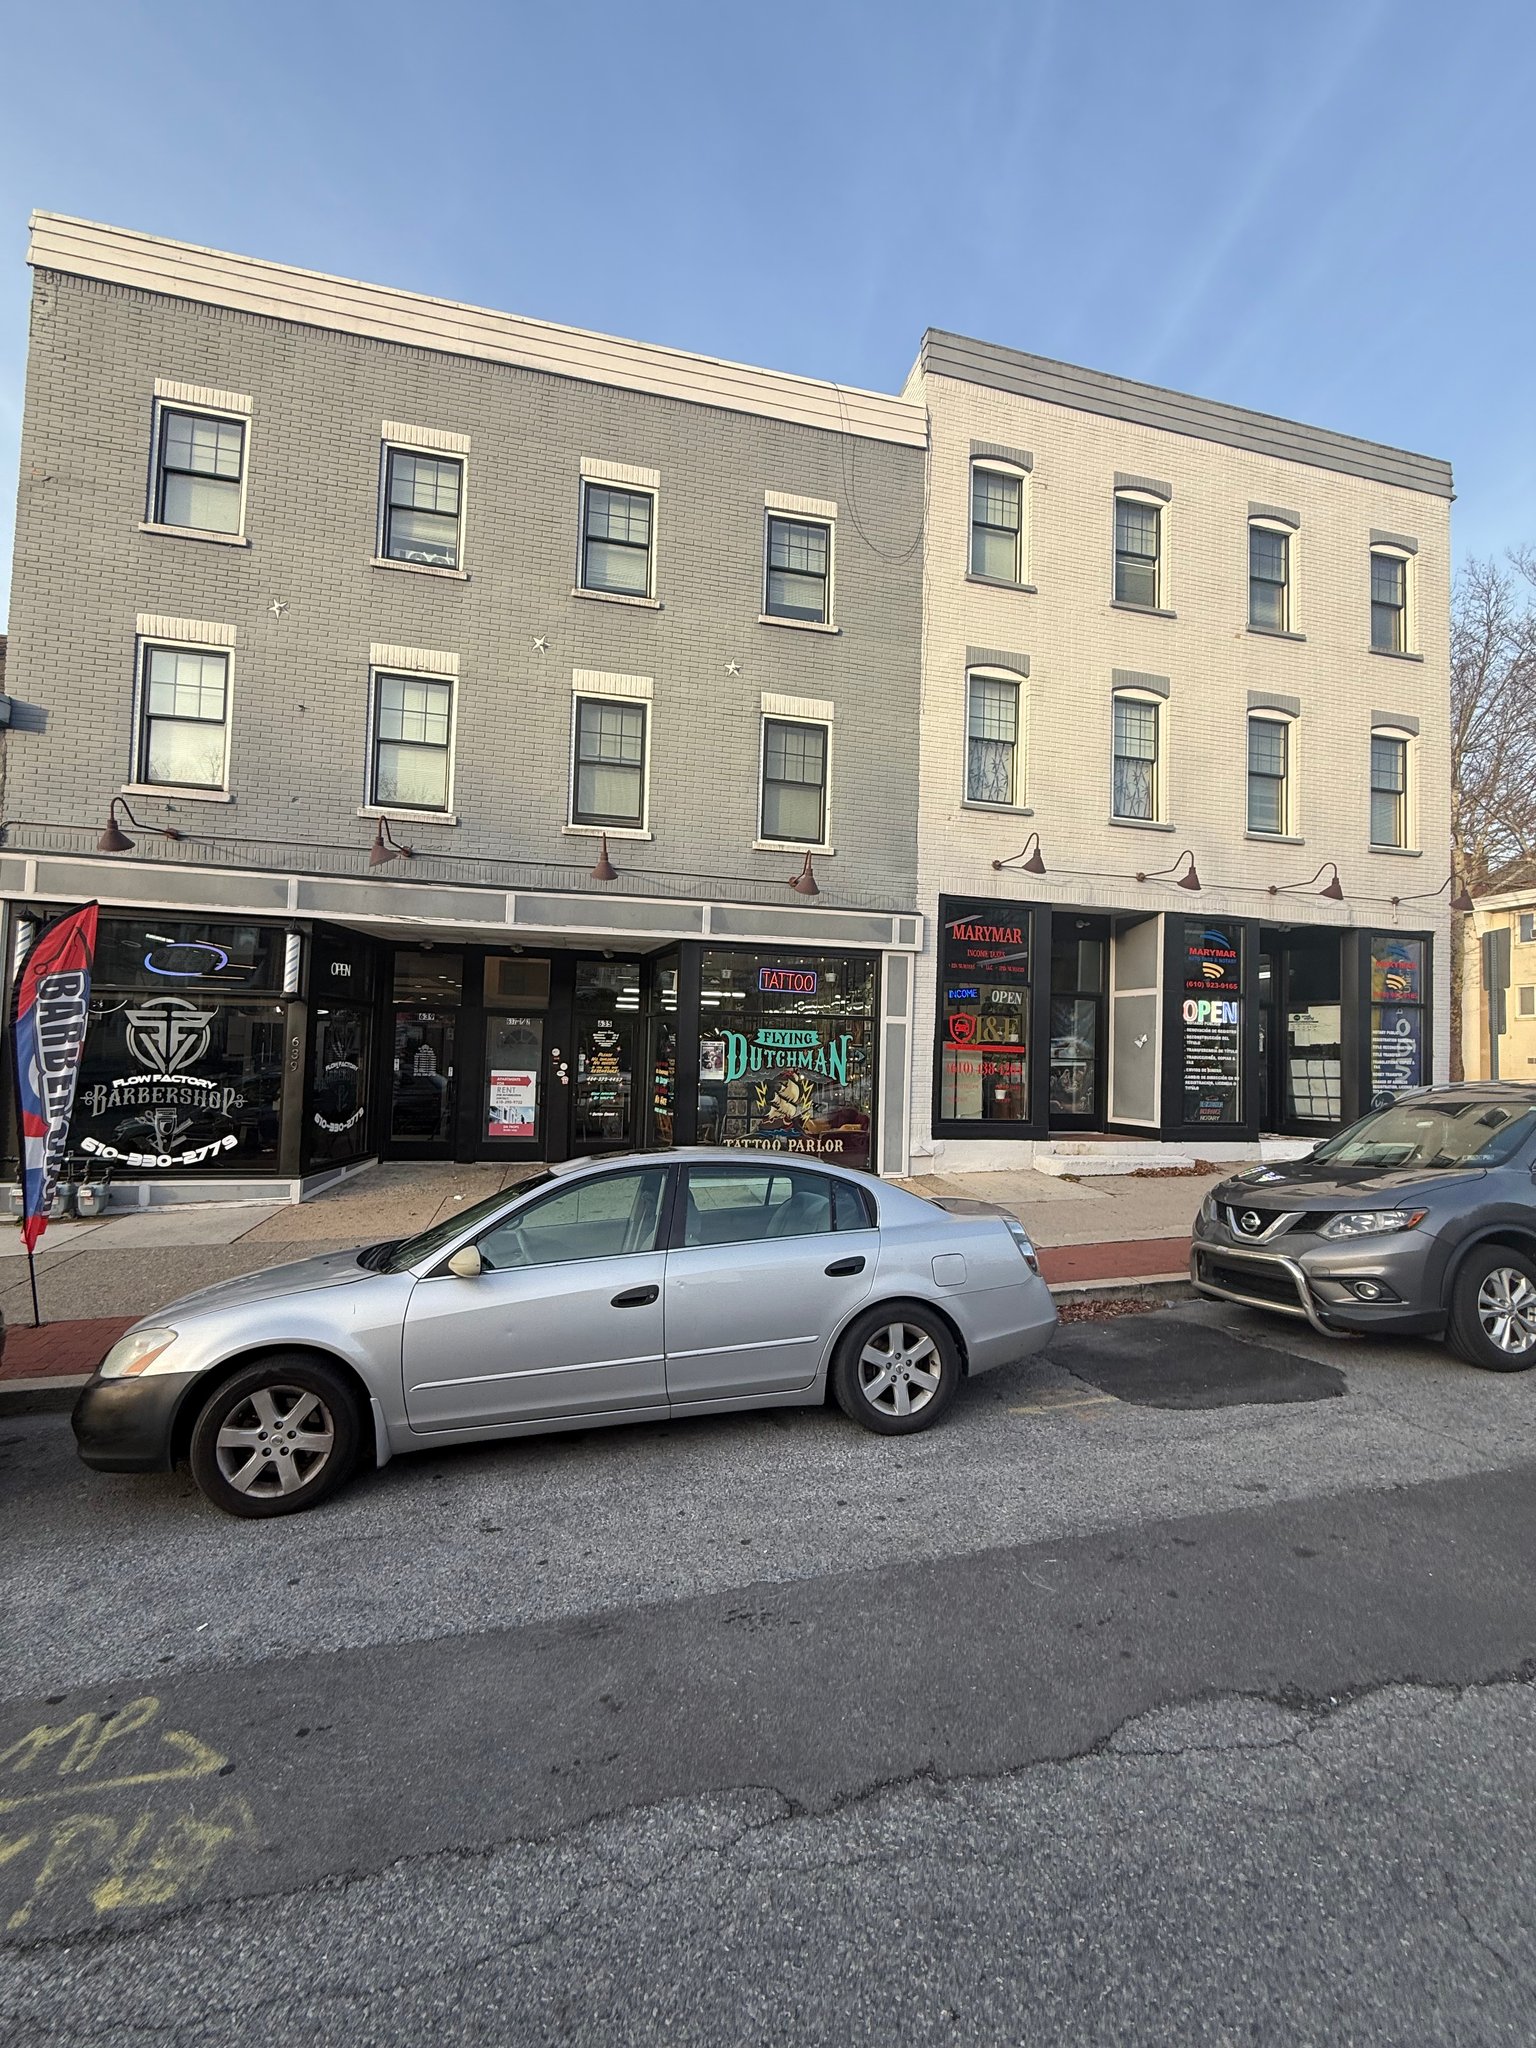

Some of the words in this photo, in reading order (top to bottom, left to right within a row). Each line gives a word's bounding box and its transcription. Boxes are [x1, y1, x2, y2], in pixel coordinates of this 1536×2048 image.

[953, 924, 1022, 944] MARYMAR
[1189, 947, 1236, 958] MARYMAR
[331, 962, 351, 977] OPEN
[762, 971, 814, 992] TATTOO
[1185, 981, 1205, 989] (610)
[949, 988, 978, 999] INCOME
[991, 990, 1022, 1005] OPEN
[1183, 999, 1238, 1024] OPEN
[764, 1031, 813, 1045] FLYING
[290, 1036, 300, 1072] 639
[720, 1030, 853, 1087] DUTCHMAN
[112, 1074, 151, 1088] FLOW
[152, 1074, 218, 1090] FACTORY
[90, 1083, 238, 1119] BARBERSHOP
[314, 1106, 365, 1133] 610-330-2779
[80, 1133, 239, 1168] 610-330-2779
[723, 1138, 782, 1151] TATTOO
[788, 1138, 844, 1153] PARLOR
